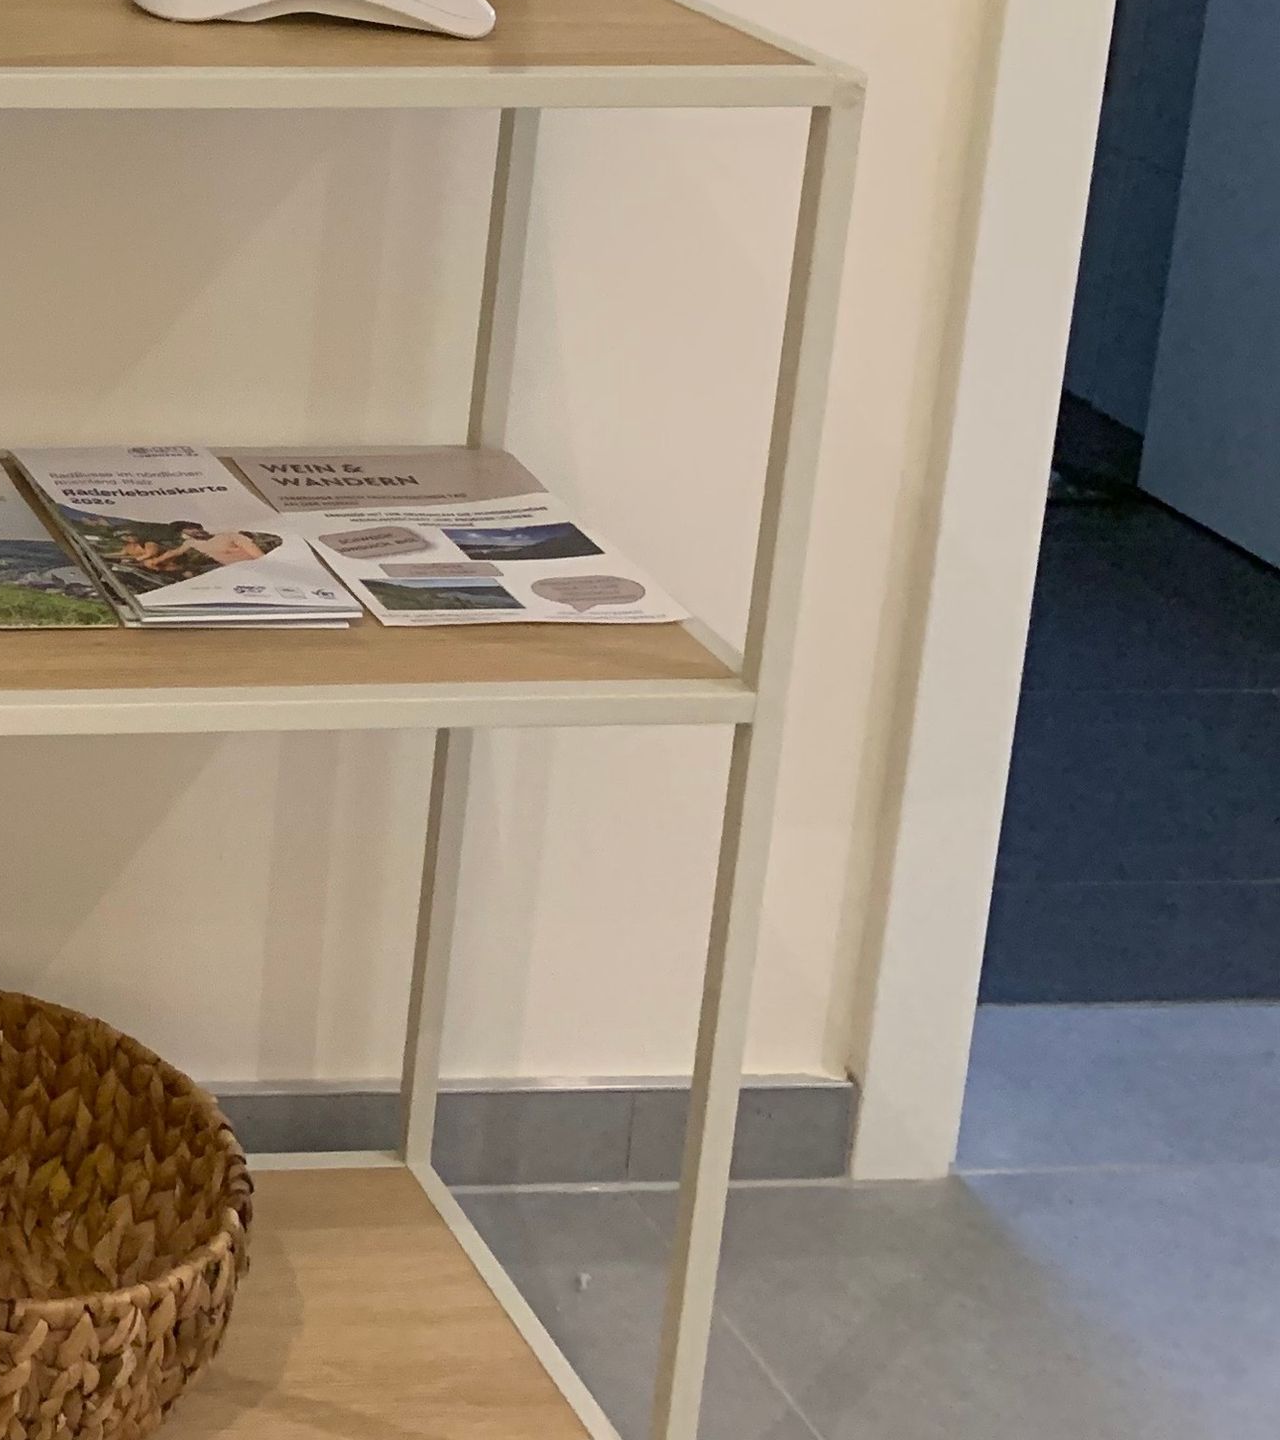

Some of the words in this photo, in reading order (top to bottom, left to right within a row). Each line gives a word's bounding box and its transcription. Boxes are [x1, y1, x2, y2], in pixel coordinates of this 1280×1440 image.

[259, 462, 336, 474] WEIN
[341, 463, 363, 474] &
[271, 475, 420, 487] WANDERN
[62, 484, 228, 498] Raderlebniskarte
